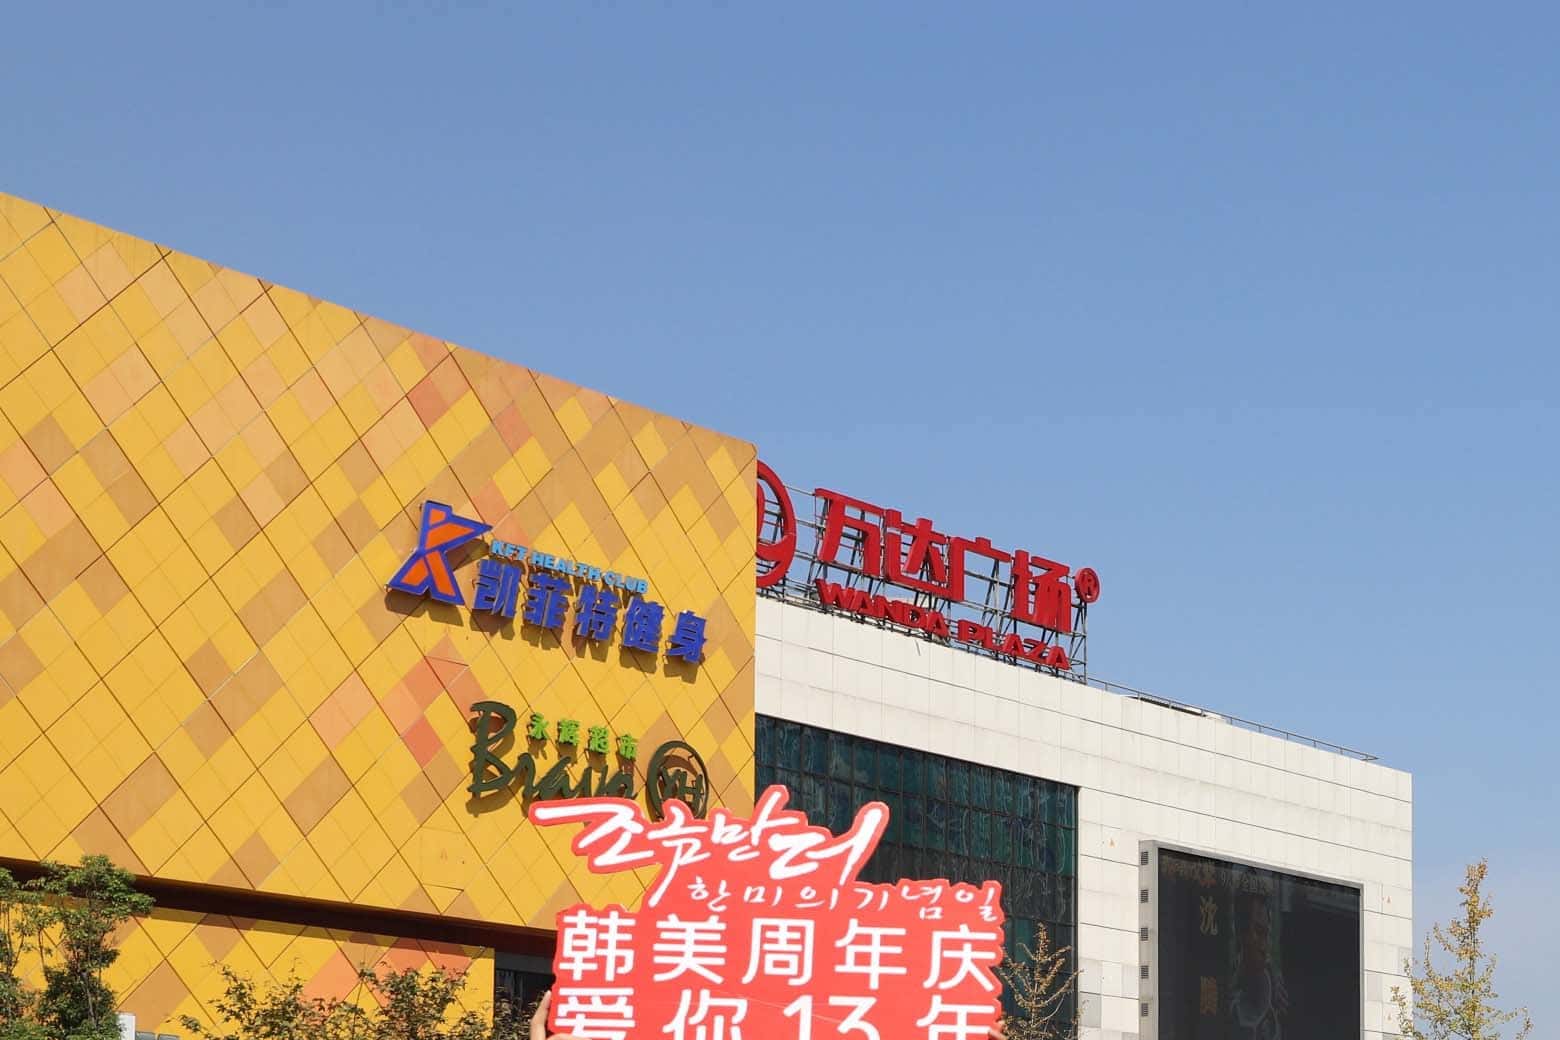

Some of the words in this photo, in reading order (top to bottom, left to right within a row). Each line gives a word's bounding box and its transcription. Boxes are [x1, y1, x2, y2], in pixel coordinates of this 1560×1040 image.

[531, 550, 600, 583] HEALTH
[604, 569, 649, 594] CLUB
[814, 488, 1072, 633] 万达广场
[472, 558, 708, 664] 凯菲特健身
[815, 578, 951, 640] WANDA
[957, 619, 1073, 670] PLAZA
[528, 712, 638, 760] 永辉超市
[558, 912, 999, 991] 韩美周年庆
